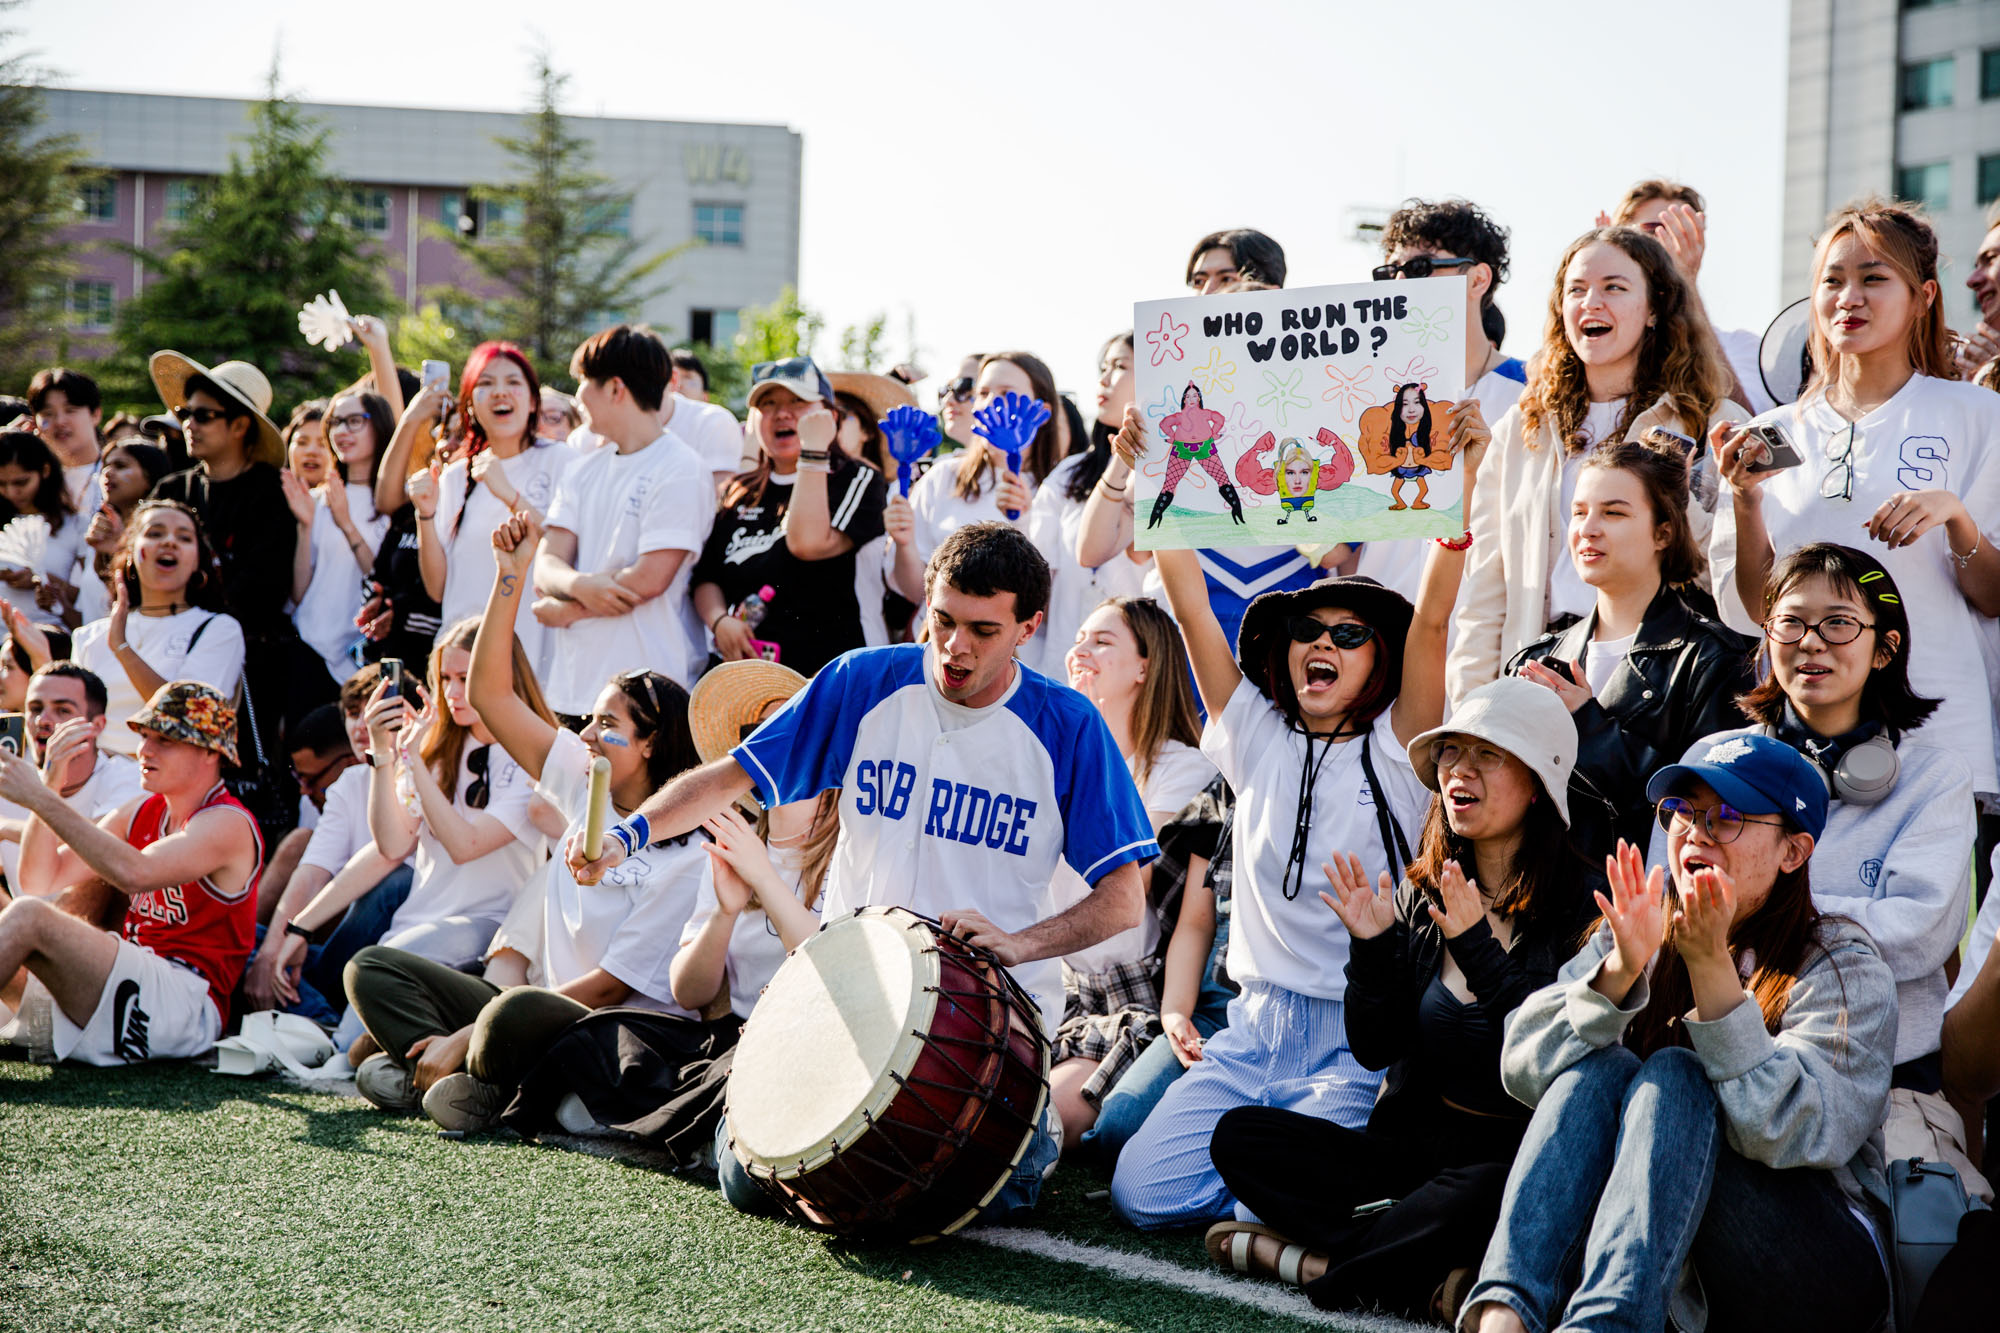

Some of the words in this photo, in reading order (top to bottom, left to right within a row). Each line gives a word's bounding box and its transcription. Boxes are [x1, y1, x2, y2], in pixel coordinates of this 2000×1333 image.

[1203, 311, 1263, 338] WHO
[1281, 303, 1346, 332] RUN
[1353, 295, 1408, 324] THE
[1897, 435, 1950, 491] S
[501, 575, 517, 597] S
[925, 778, 1038, 857] RIDGE
